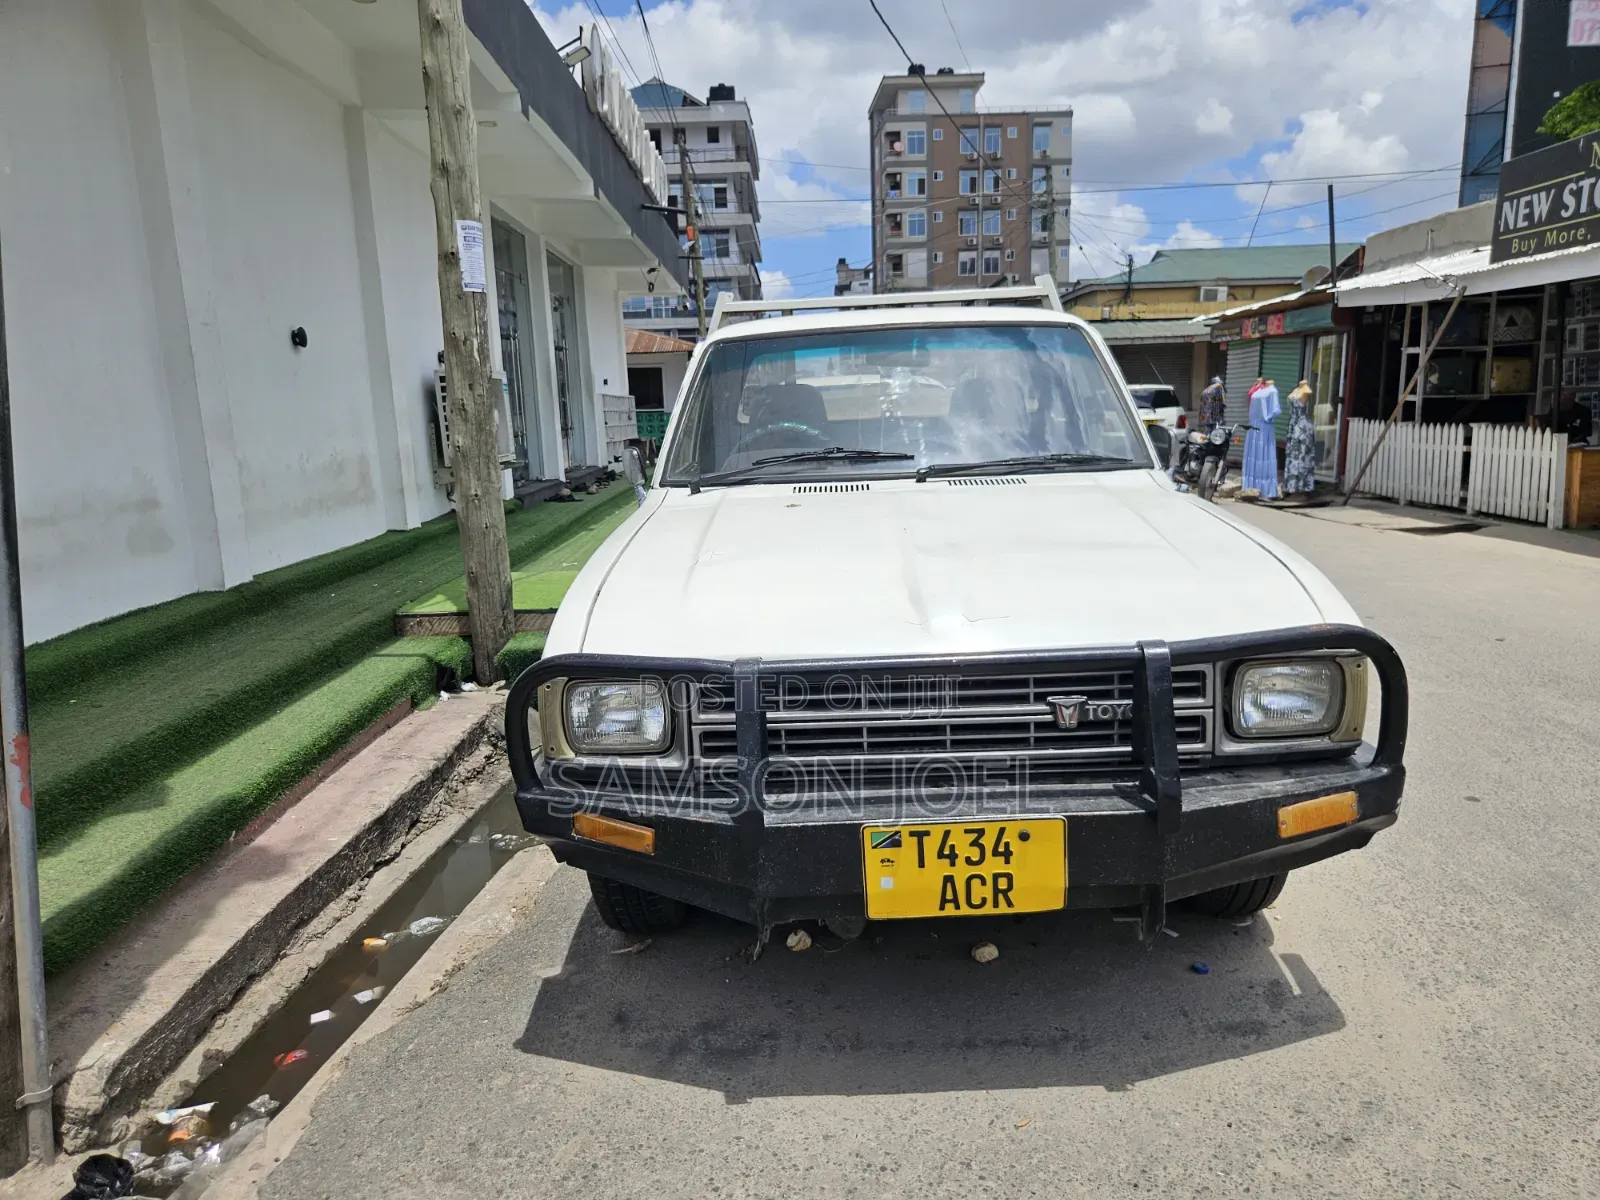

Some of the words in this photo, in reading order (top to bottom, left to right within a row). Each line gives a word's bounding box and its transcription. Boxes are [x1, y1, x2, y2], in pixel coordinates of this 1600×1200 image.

[1500, 188, 1556, 232] NEW
[1511, 238, 1537, 254] Buy
[1544, 227, 1591, 247] More,
[909, 827, 1014, 868] T434
[938, 872, 1015, 911] ACR
